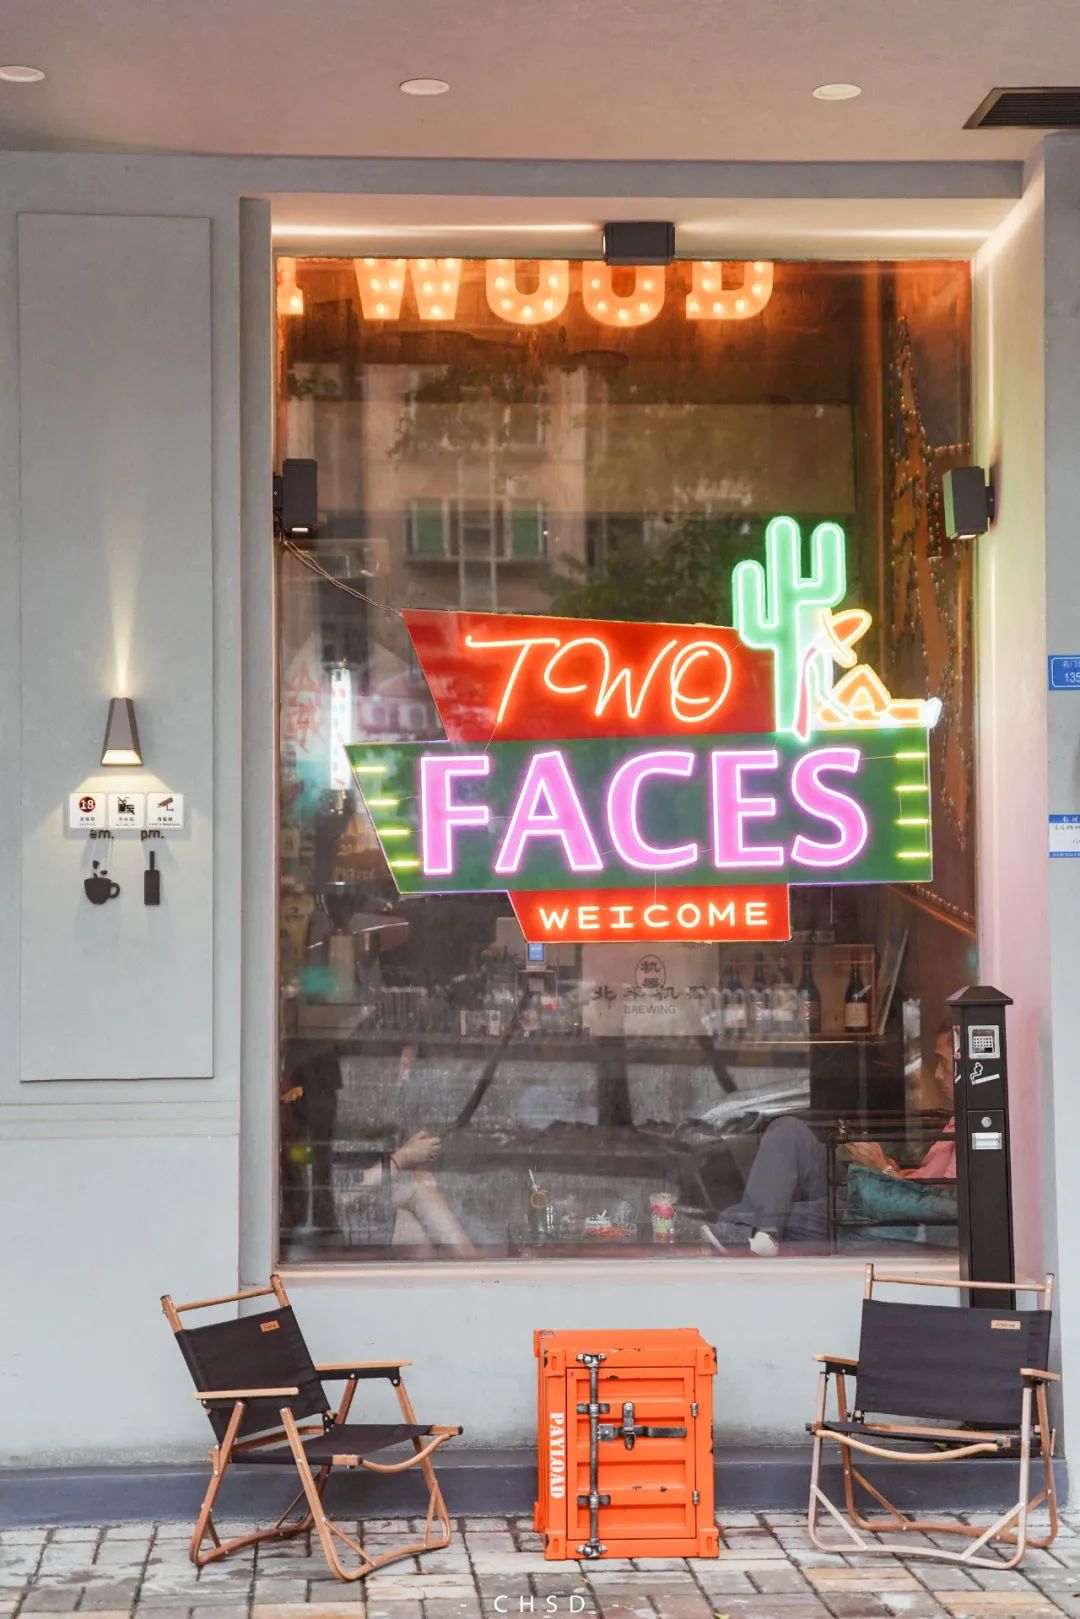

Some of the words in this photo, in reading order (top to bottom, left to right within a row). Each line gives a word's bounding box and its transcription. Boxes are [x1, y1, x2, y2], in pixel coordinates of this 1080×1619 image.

[464, 634, 732, 724] TWO
[419, 747, 870, 876] FACES
[623, 1004, 677, 1015] BREWING
[549, 1412, 565, 1500] PAYLOAD
